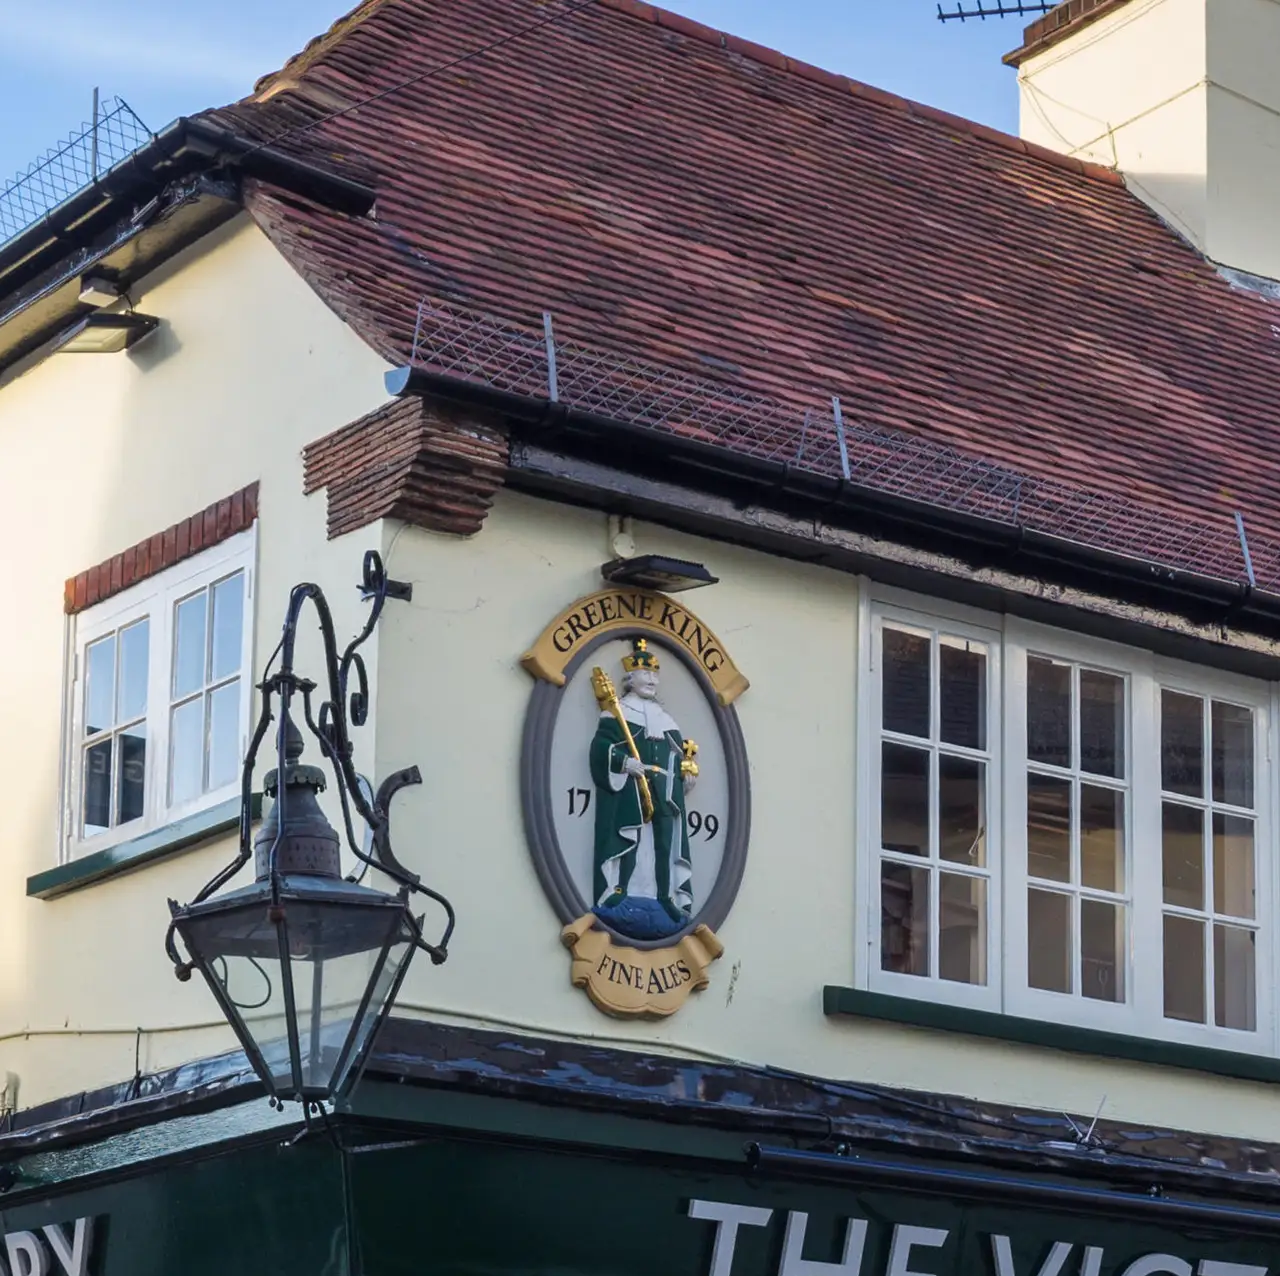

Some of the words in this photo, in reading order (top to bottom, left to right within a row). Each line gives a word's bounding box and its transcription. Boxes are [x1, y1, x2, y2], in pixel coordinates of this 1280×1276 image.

[552, 594, 654, 653] GREENE
[657, 602, 725, 673] KING
[567, 786, 592, 817] 17
[687, 810, 719, 841] 99
[597, 952, 644, 990] FINE
[646, 958, 692, 995] ALES
